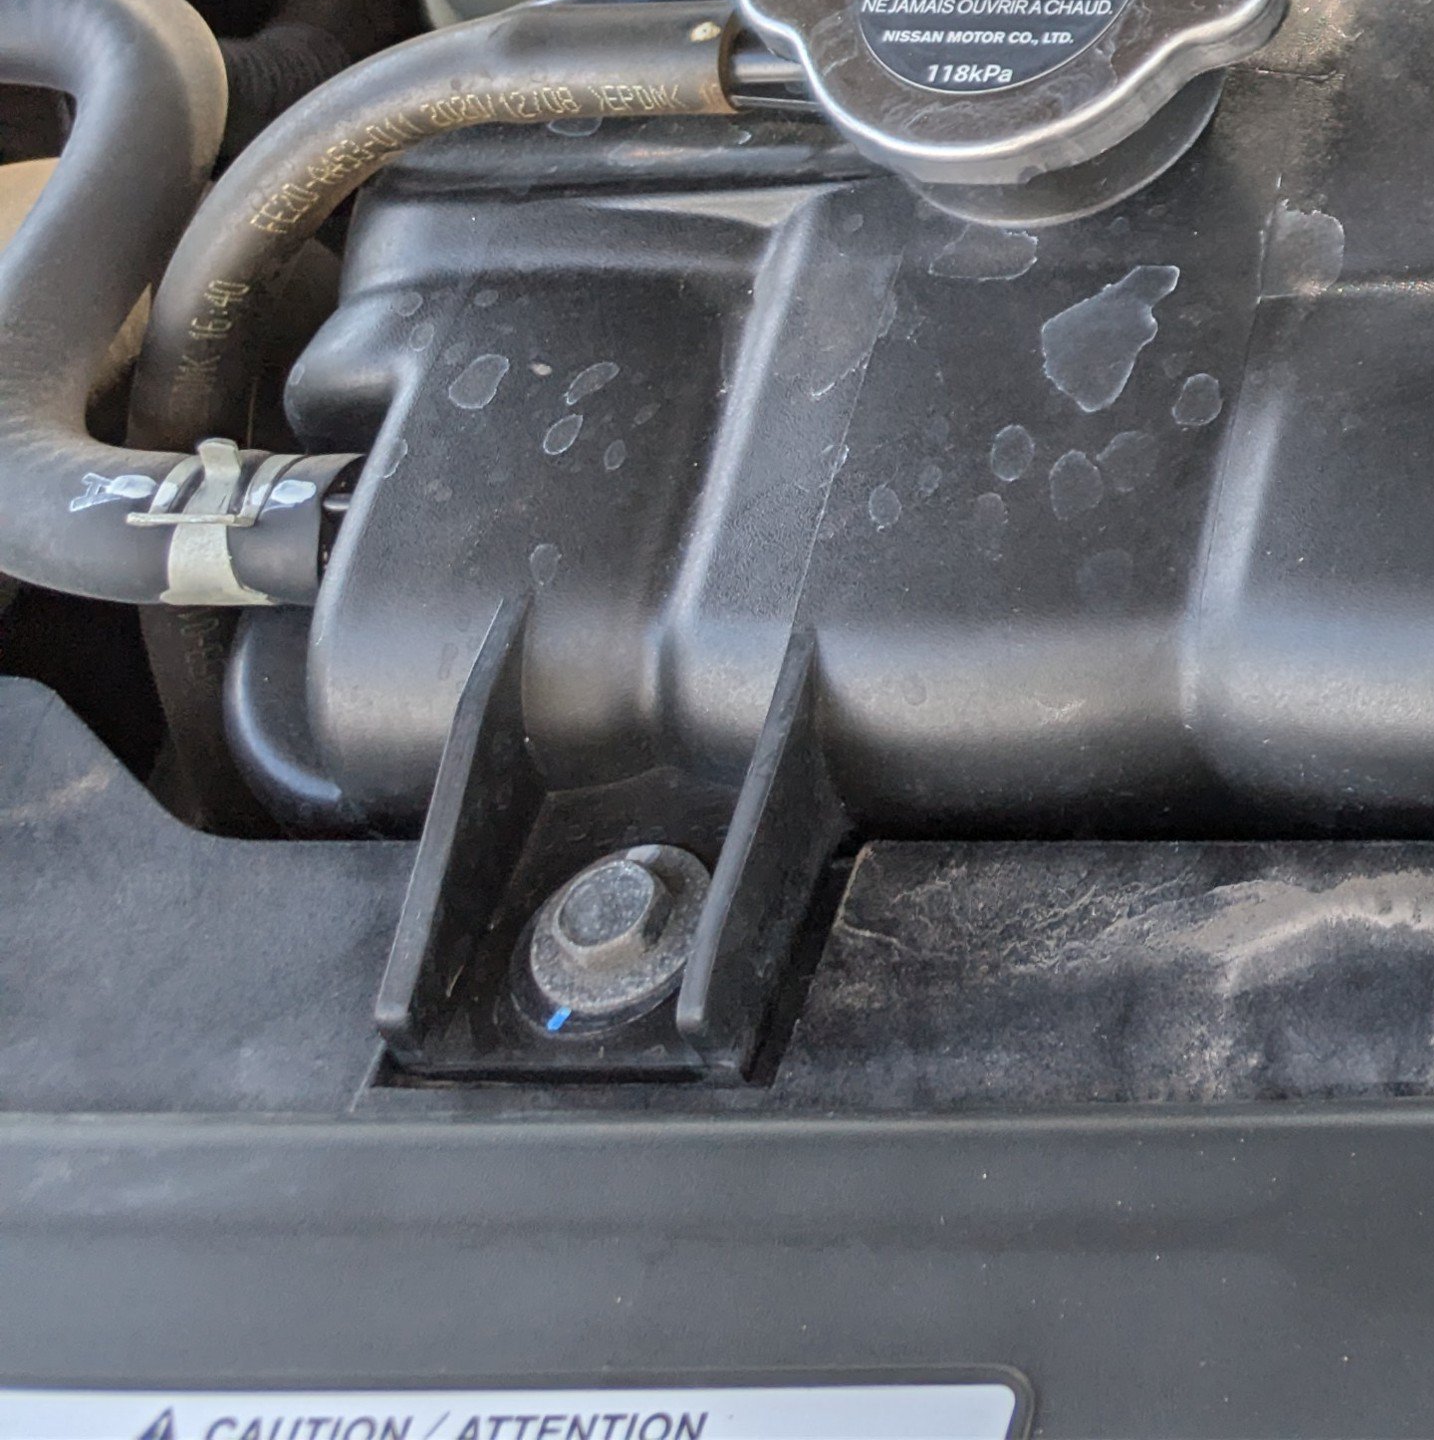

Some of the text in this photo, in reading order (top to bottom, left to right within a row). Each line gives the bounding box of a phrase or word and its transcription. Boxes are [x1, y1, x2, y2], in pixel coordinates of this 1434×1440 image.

[1044, 0, 1113, 15] CHAUD.
[883, 30, 1075, 46] NISSAN MOTOR CO., LTD.
[927, 64, 1013, 83] 118kPa
[420, 86, 582, 127] 2020/12/08
[187, 279, 251, 340] 16:40
[204, 1415, 414, 1440] CAUTION
[453, 1410, 709, 1440] ATTENTION
